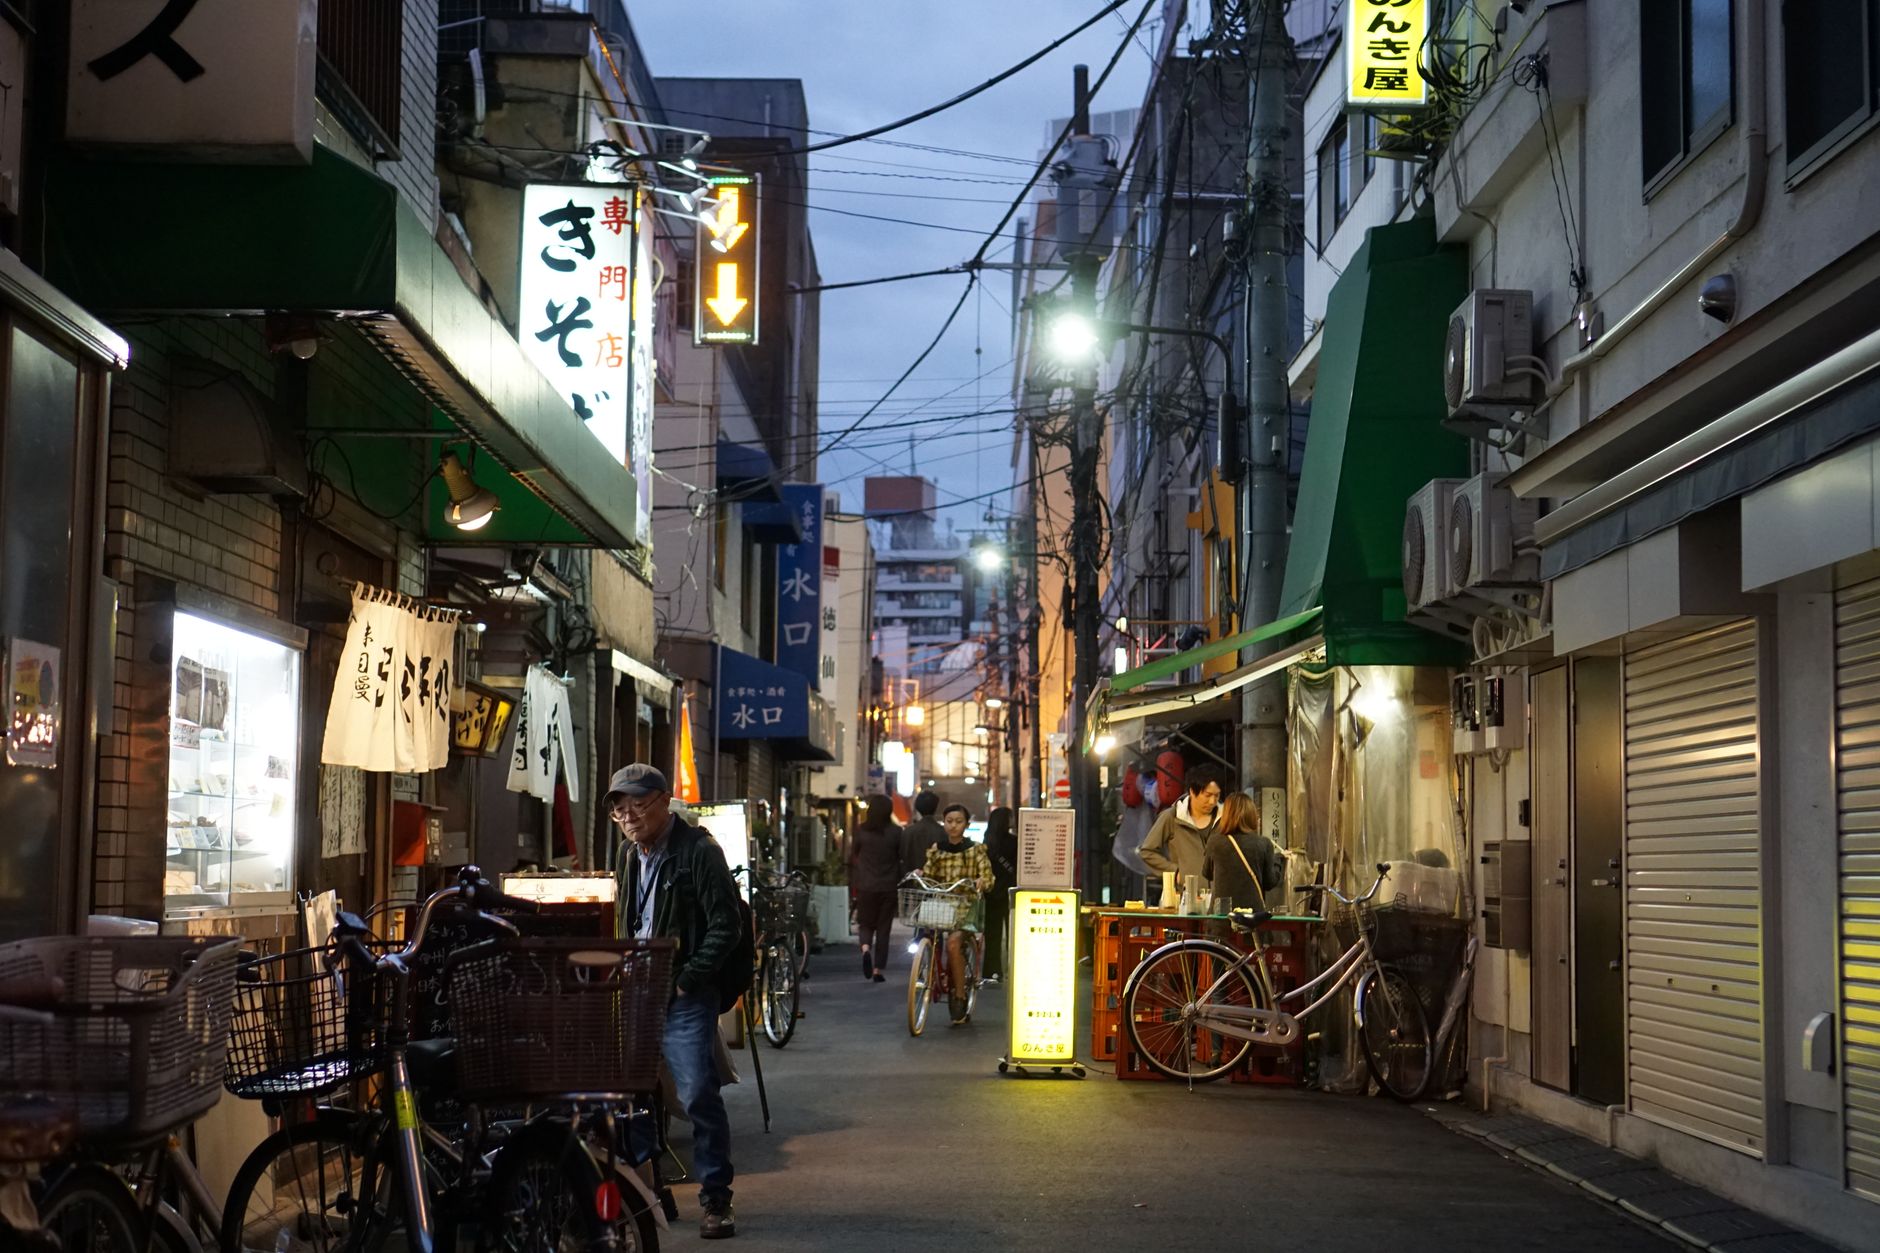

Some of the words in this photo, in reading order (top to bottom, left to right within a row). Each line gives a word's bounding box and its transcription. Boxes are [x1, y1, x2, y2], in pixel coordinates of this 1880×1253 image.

[1363, 0, 1412, 91] んき屋
[595, 196, 632, 368] 専門店
[801, 499, 815, 543] 食事処
[782, 567, 817, 646] 水口
[732, 703, 783, 730] 水口
